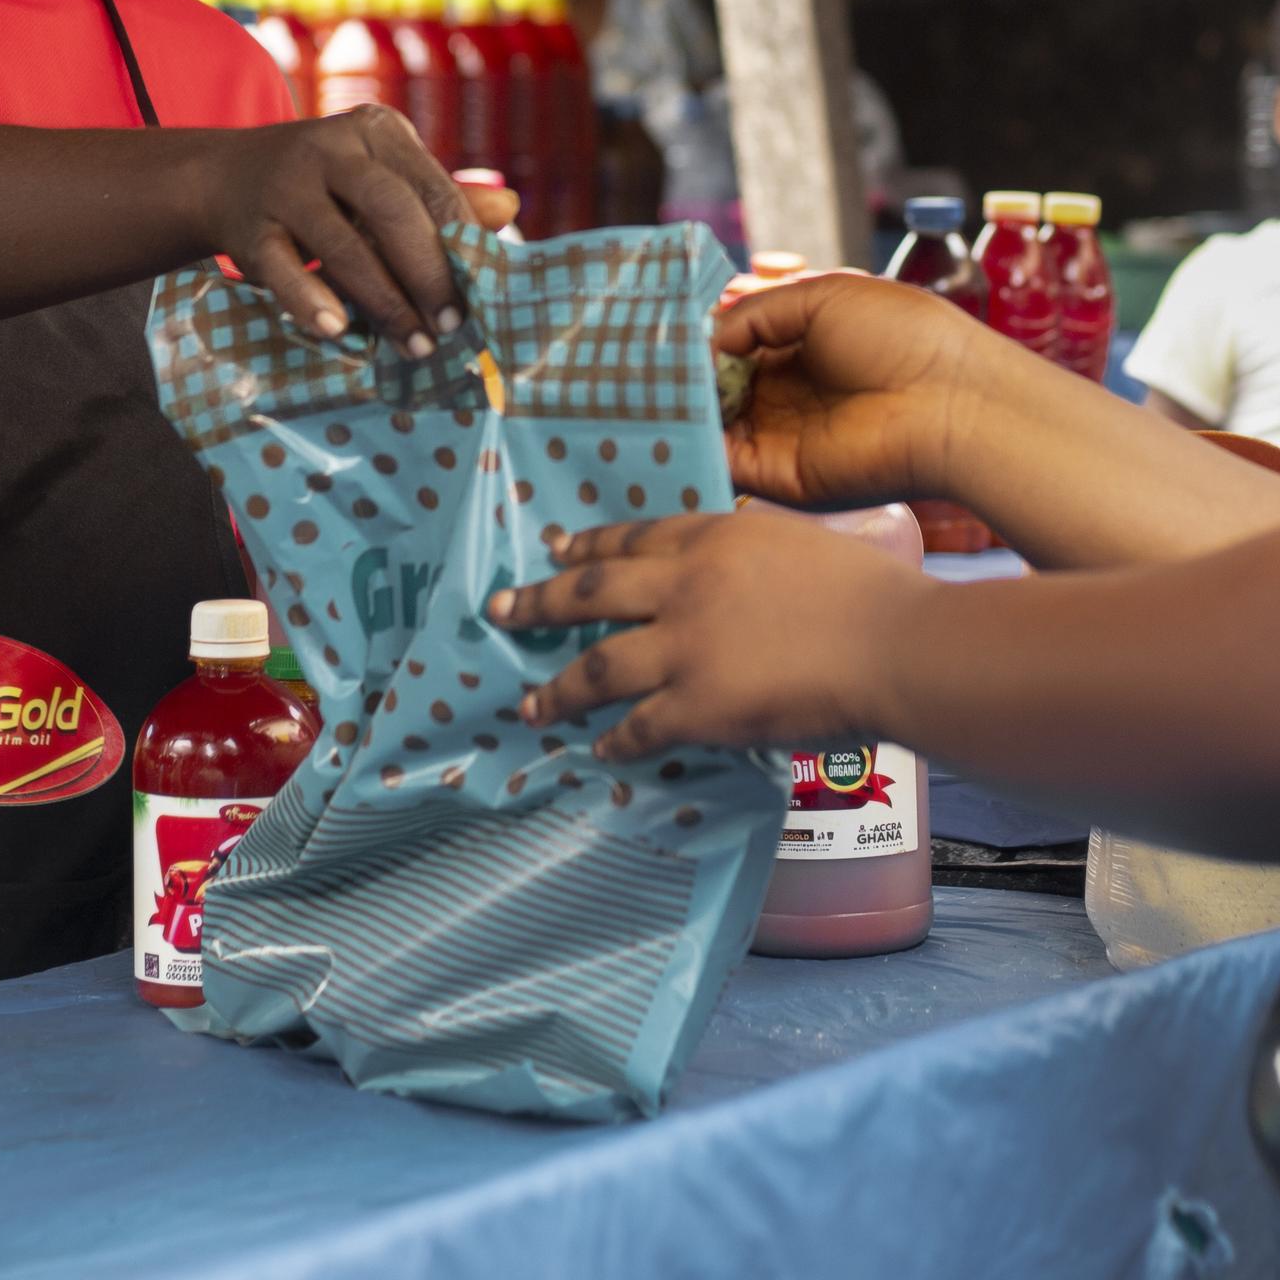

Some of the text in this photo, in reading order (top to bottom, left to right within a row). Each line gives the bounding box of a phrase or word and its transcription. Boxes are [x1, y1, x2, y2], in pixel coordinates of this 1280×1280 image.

[29, 734, 51, 746] Oil
[830, 752, 860, 763] 100%
[791, 759, 816, 783] Oil
[828, 764, 861, 777] ORGANIC
[856, 829, 903, 846] GHANA
[188, 913, 203, 938] P
[167, 964, 201, 973] 0592911
